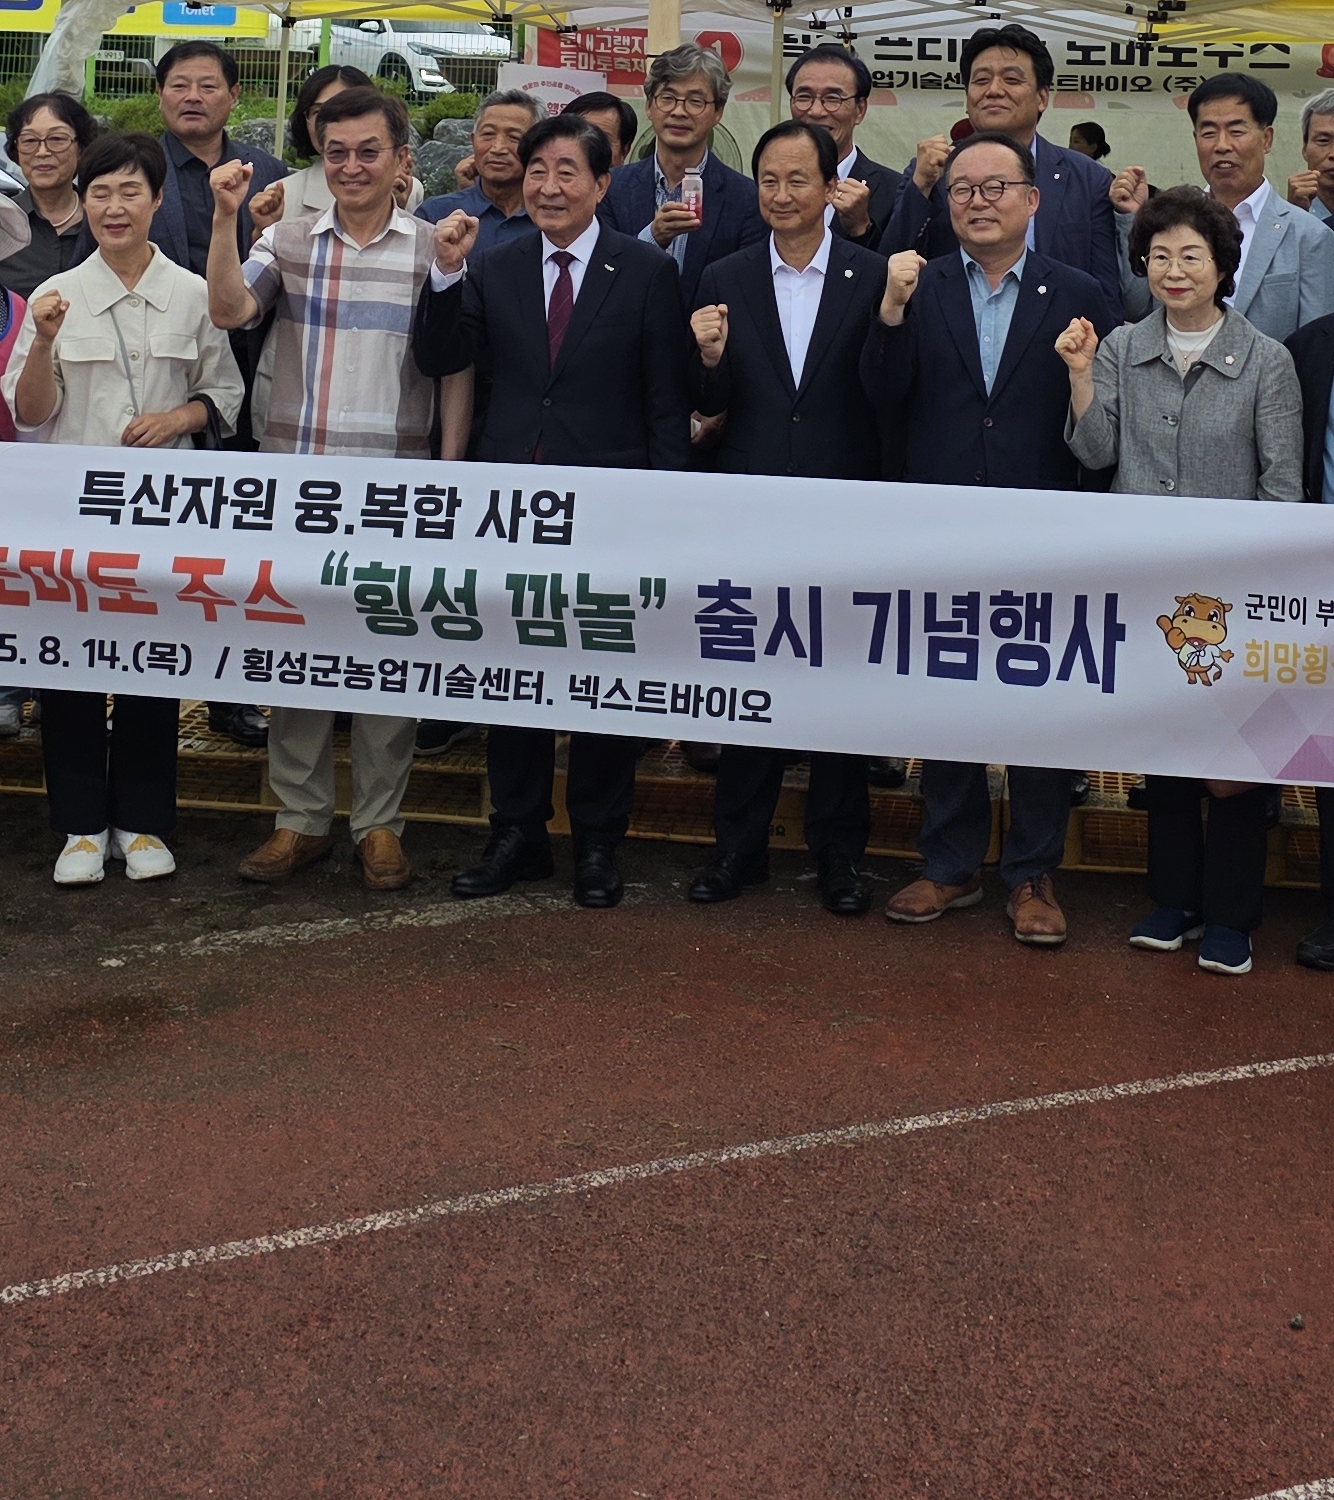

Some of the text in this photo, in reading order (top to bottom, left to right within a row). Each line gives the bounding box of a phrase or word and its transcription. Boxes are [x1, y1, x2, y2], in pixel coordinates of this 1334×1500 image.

[78, 470, 278, 530] 특산자원
[474, 489, 578, 548] 사업
[171, 555, 307, 626] 주스
[694, 578, 825, 668] 출시
[852, 590, 1130, 695] 기념행사
[1244, 593, 1308, 626] 군민이
[38, 635, 71, 668] 8.
[567, 674, 775, 725] 넥스트바이오
